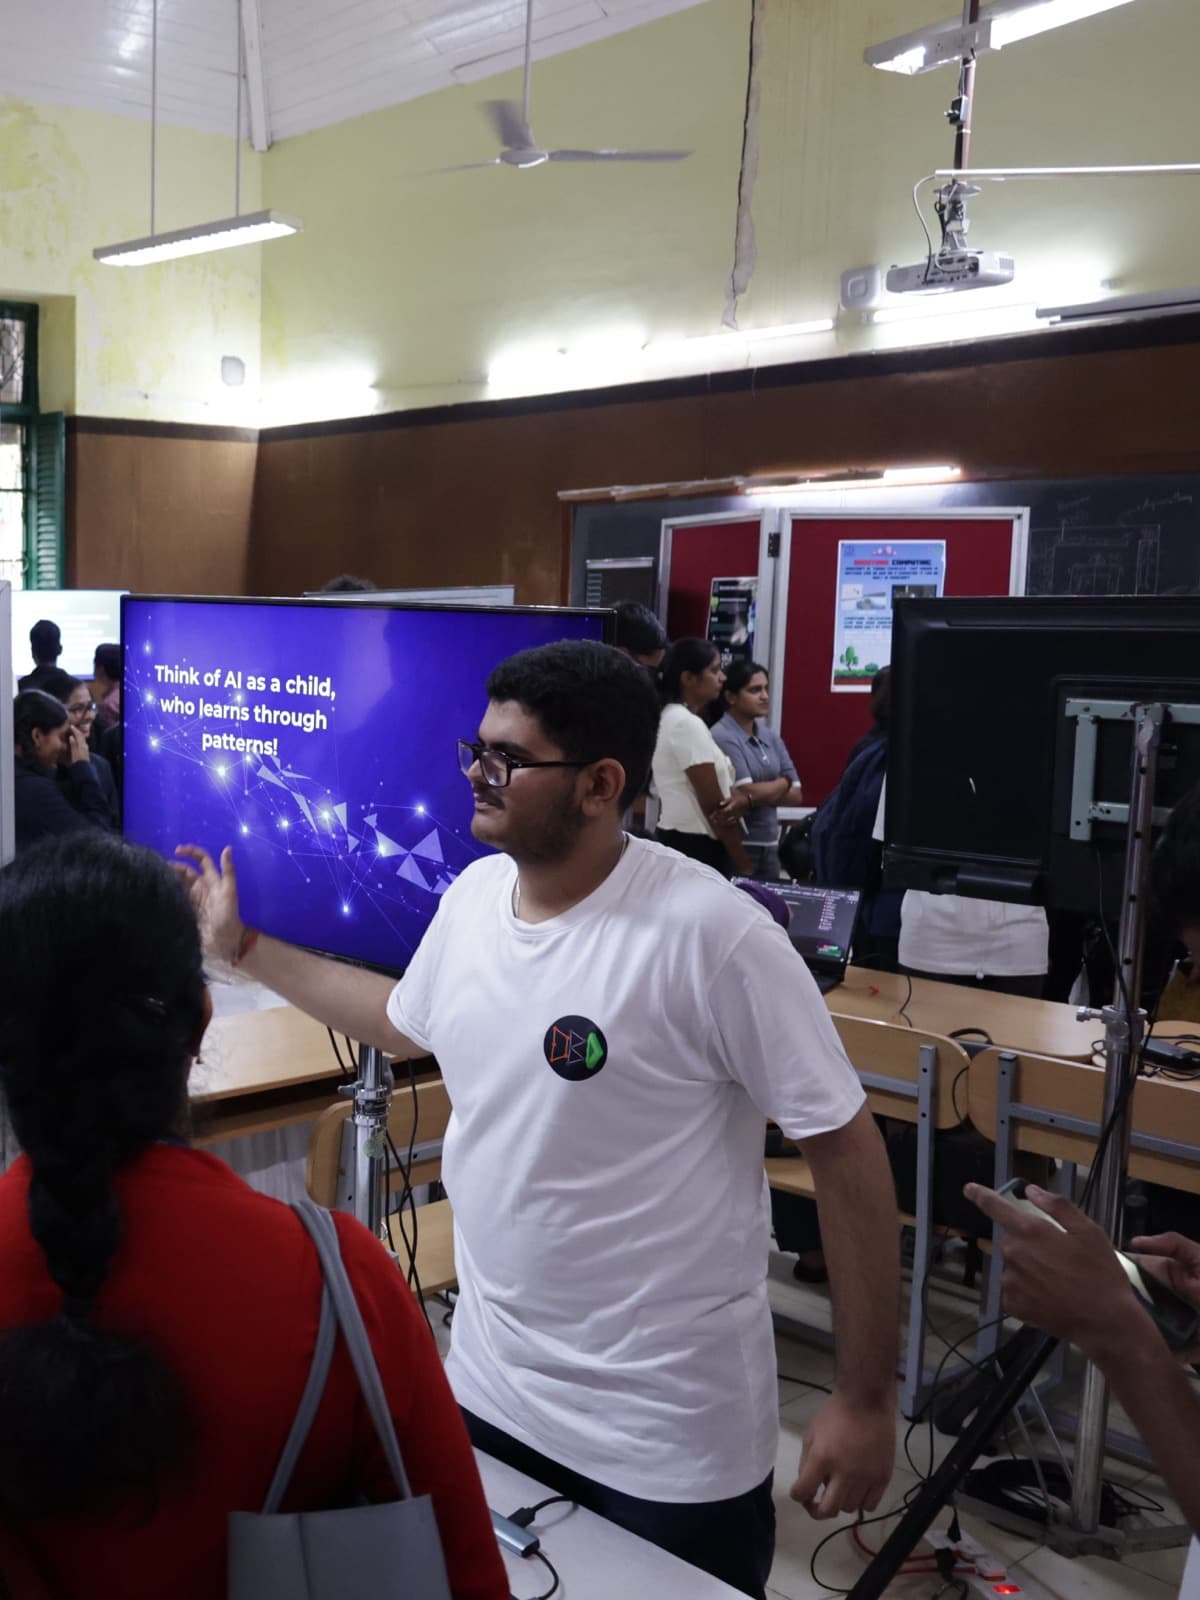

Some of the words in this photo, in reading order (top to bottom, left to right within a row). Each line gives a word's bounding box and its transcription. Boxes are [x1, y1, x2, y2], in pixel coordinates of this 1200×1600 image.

[154, 664, 200, 686] Think
[203, 669, 222, 687] of
[224, 670, 242, 689] AI
[246, 675, 266, 691] as
[270, 677, 281, 693] a
[285, 674, 336, 701] child,
[160, 696, 195, 715] who
[199, 697, 250, 721] learns
[253, 703, 328, 733] through
[202, 732, 279, 756] patterns!
